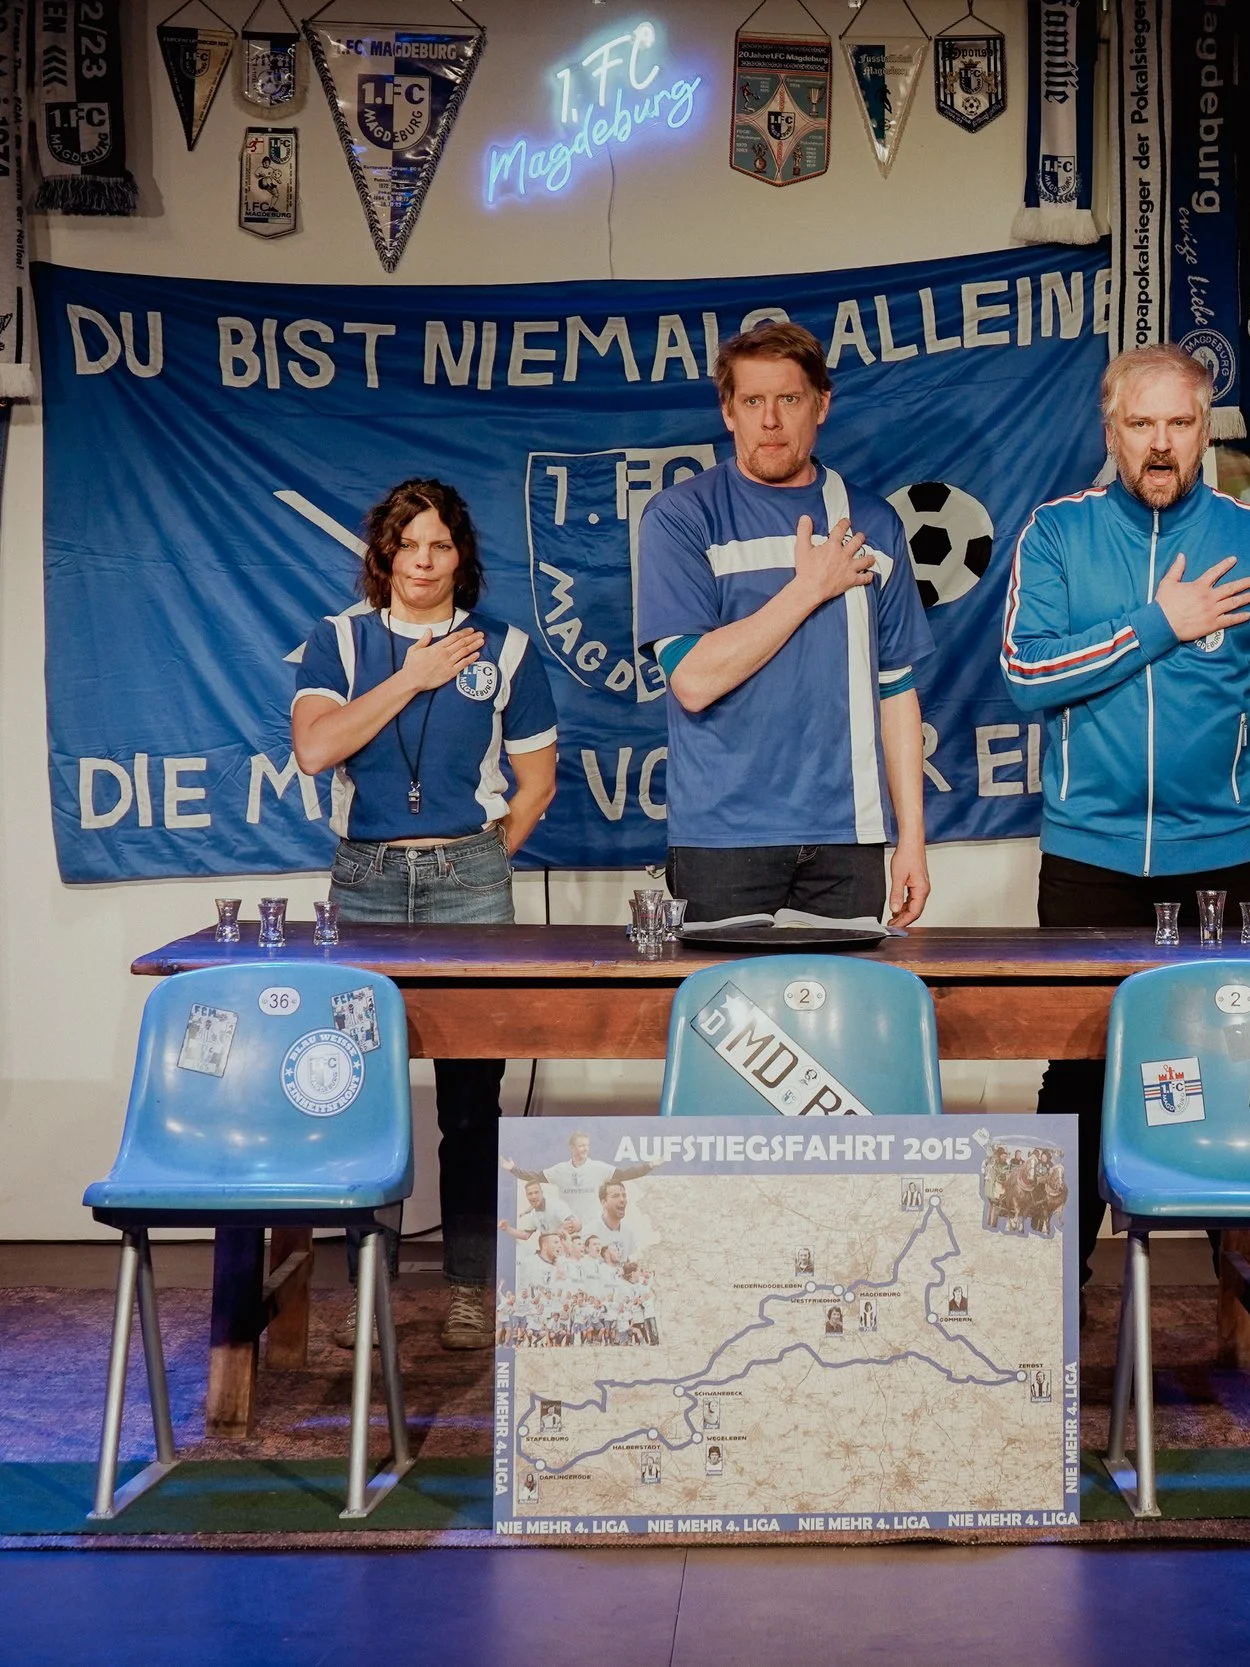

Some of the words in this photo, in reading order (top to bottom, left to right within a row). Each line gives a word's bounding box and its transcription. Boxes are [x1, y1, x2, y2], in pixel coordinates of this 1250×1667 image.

[370, 41, 457, 60] MAGDEBURG
[786, 53, 829, 65] Magdeburg
[363, 108, 424, 142] MAGDEBURG
[1191, 10, 1224, 214] agdeburg
[49, 132, 110, 164] MAGDEBURG
[486, 76, 701, 202] Magdeburg
[1132, 133, 1149, 170] der
[1043, 174, 1073, 194] MAGDEBURG
[245, 211, 291, 219] MAGDEBURG
[15, 229, 25, 270] Nation!
[1132, 178, 1154, 350] opapokalsieger
[66, 303, 163, 378] DU
[217, 315, 396, 389] BIST
[1186, 335, 1230, 376] MAGDEBURG
[538, 561, 667, 693] MAGDE
[1194, 631, 1221, 650] GDEBURG
[460, 676, 493, 697] MAGDEBURG
[79, 752, 212, 830] DIE
[580, 745, 668, 821] VO
[269, 993, 289, 1009] 36
[333, 992, 355, 1006] FCM
[799, 988, 810, 1004] 2
[1230, 991, 1241, 1007] 2
[194, 1005, 217, 1017] FCM
[289, 1035, 317, 1061] BLAU
[700, 1009, 726, 1036] D
[725, 1020, 798, 1088] MD
[613, 1135, 896, 1163] AUFSTIEGSFAHRT
[903, 1136, 972, 1161] 2015
[496, 1361, 510, 1388] NIE
[1064, 1361, 1078, 1398] LIGA
[496, 1392, 509, 1438] MEHR
[1066, 1401, 1078, 1416] 4.
[496, 1440, 508, 1455] 4.
[1065, 1418, 1078, 1464] MEHR
[495, 1458, 508, 1496] LIGA
[1065, 1467, 1078, 1494] NIE
[496, 1520, 523, 1534] NIE
[526, 1520, 571, 1534] MEHR
[574, 1520, 589, 1534] 4.
[593, 1520, 630, 1533] LIGA
[647, 1519, 675, 1532] NIE
[679, 1519, 722, 1532] MEHR
[725, 1519, 740, 1532] 4.
[743, 1518, 781, 1531] LIGA
[798, 1517, 825, 1530] NIE
[828, 1517, 873, 1530] MEHR
[876, 1516, 890, 1530] 4.
[893, 1516, 931, 1529] LIGA
[947, 1513, 975, 1527] NIE
[978, 1513, 1022, 1526] MEHR
[1025, 1512, 1039, 1526] 4.
[1042, 1512, 1079, 1525] LIGA
